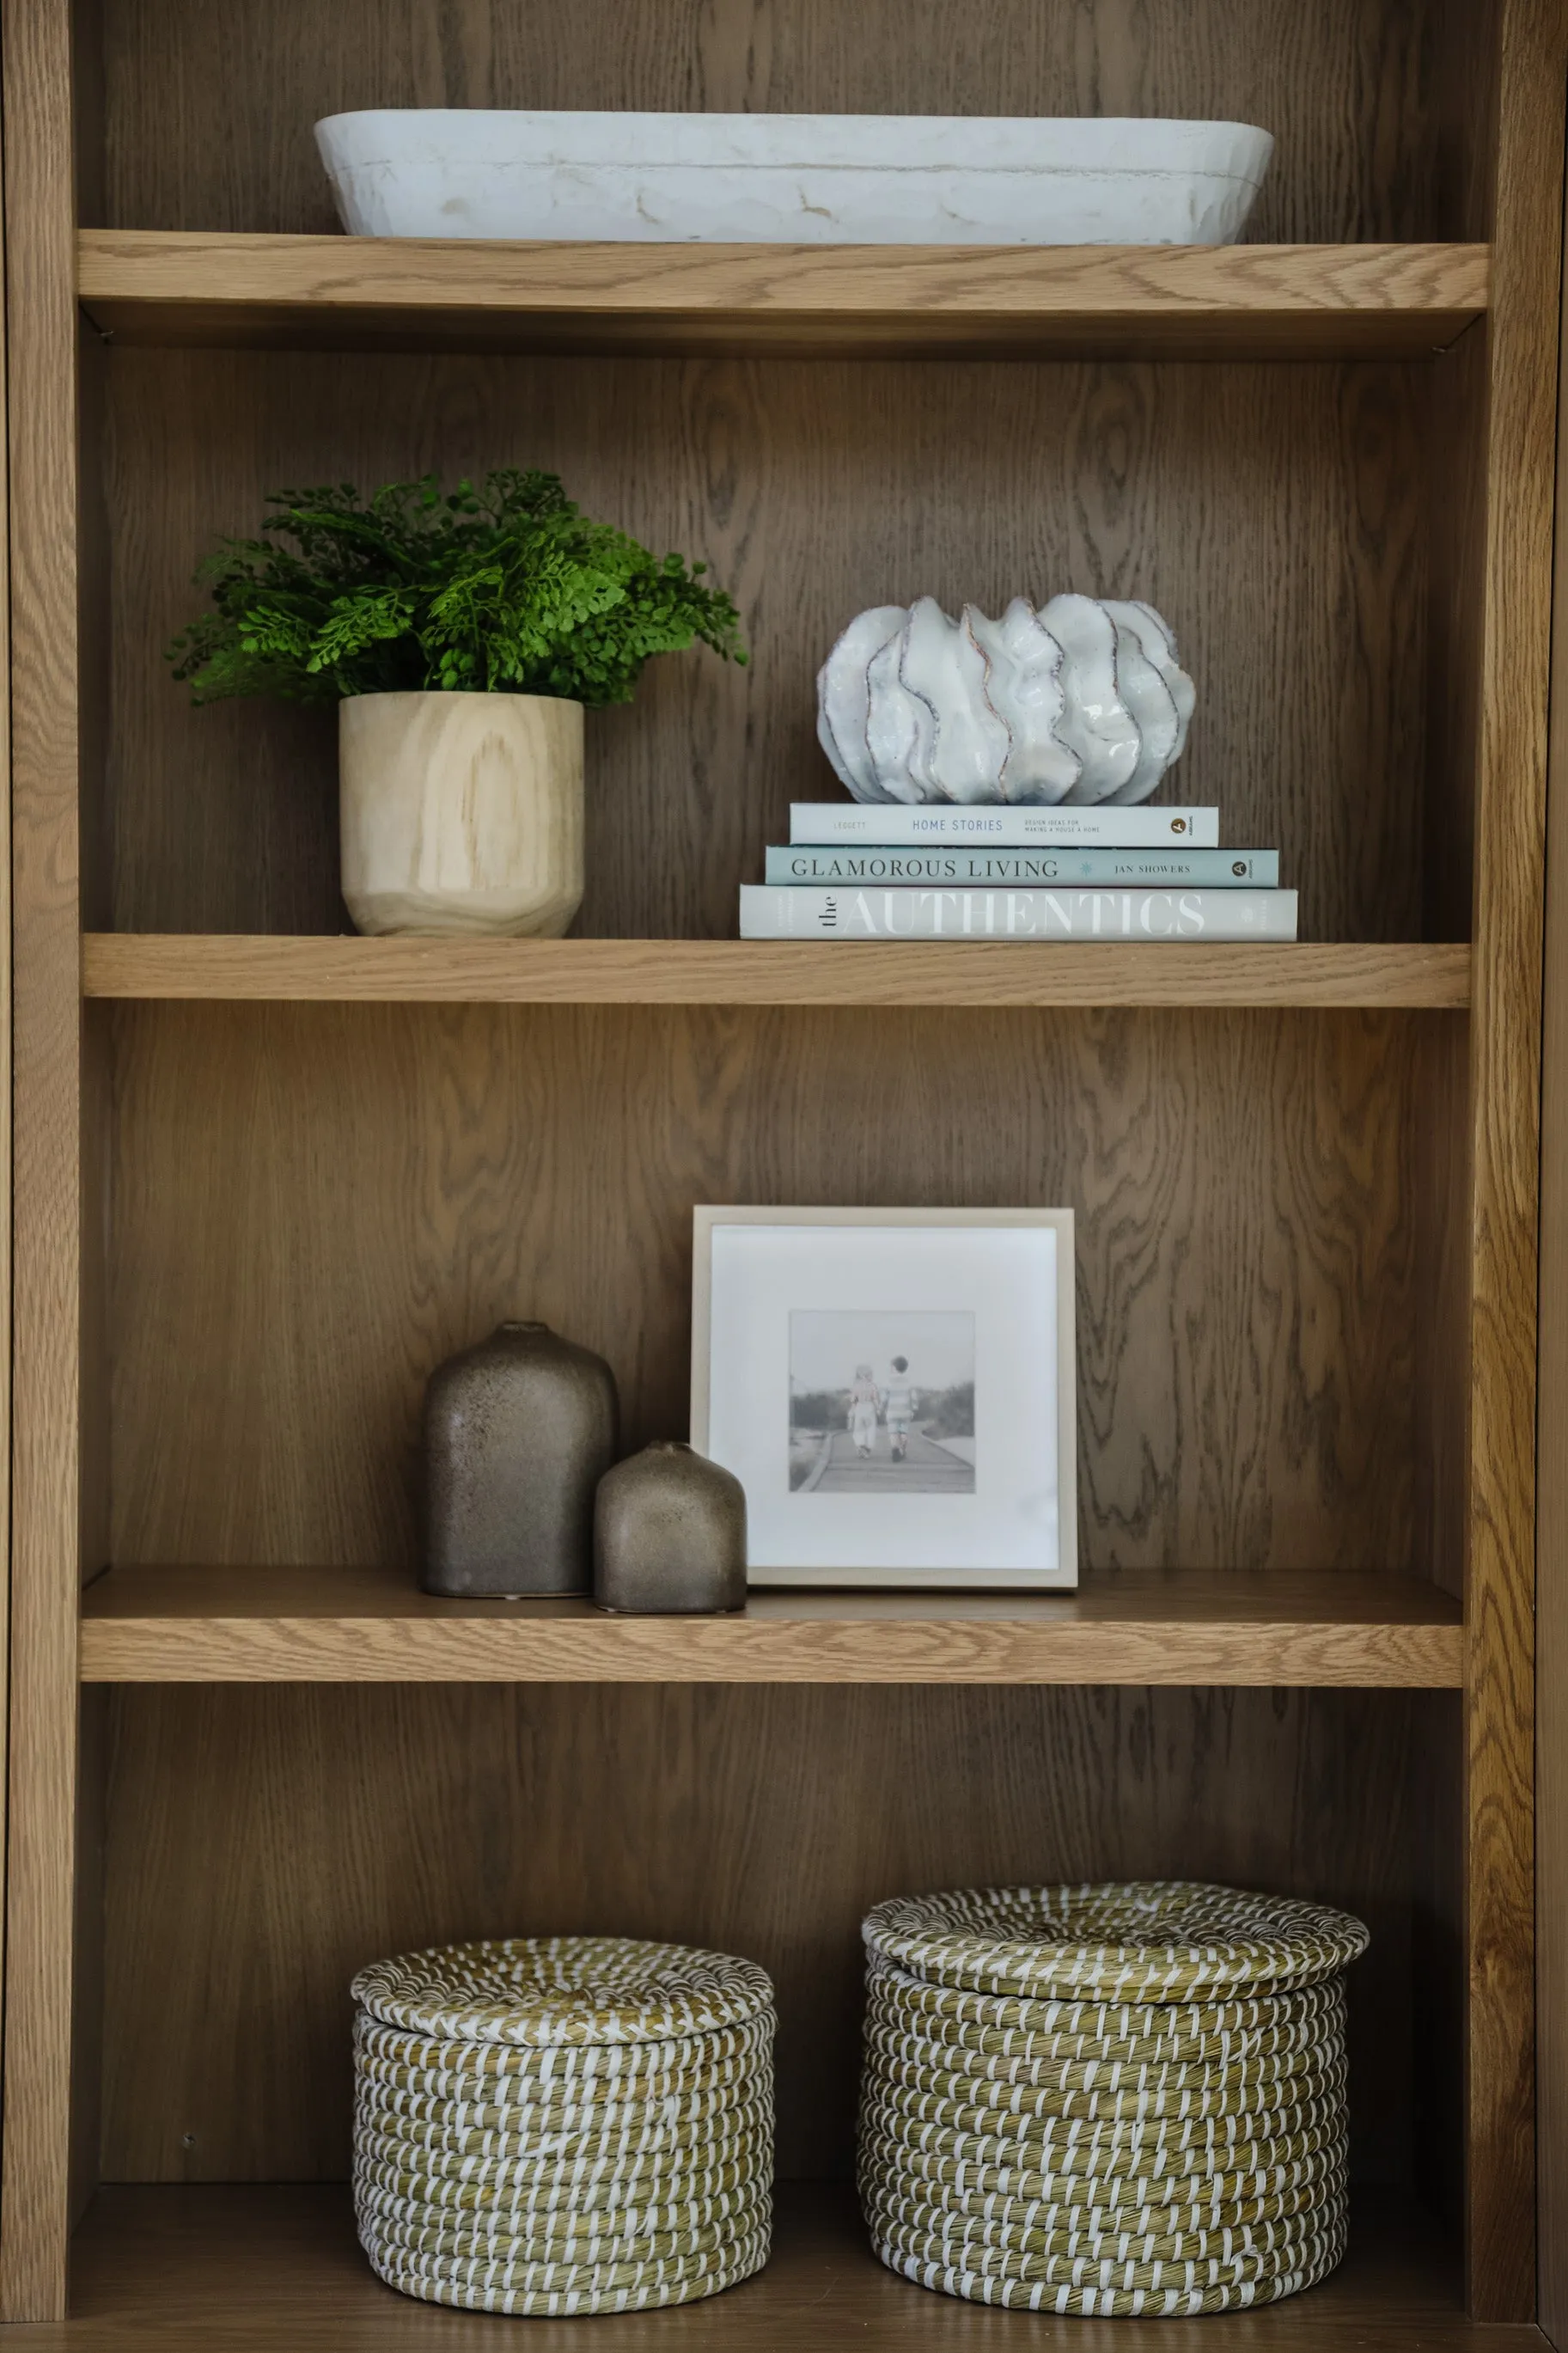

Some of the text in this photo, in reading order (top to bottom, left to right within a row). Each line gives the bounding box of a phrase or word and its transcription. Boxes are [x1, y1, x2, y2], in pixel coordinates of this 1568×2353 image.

[912, 819, 1004, 831] HOME STORIES
[790, 859, 1059, 877] GLAMOROUS LIVING
[1114, 865, 1191, 874] JAN SHOWERS
[819, 896, 837, 926] the
[840, 890, 1205, 935] AUTHENTICS
